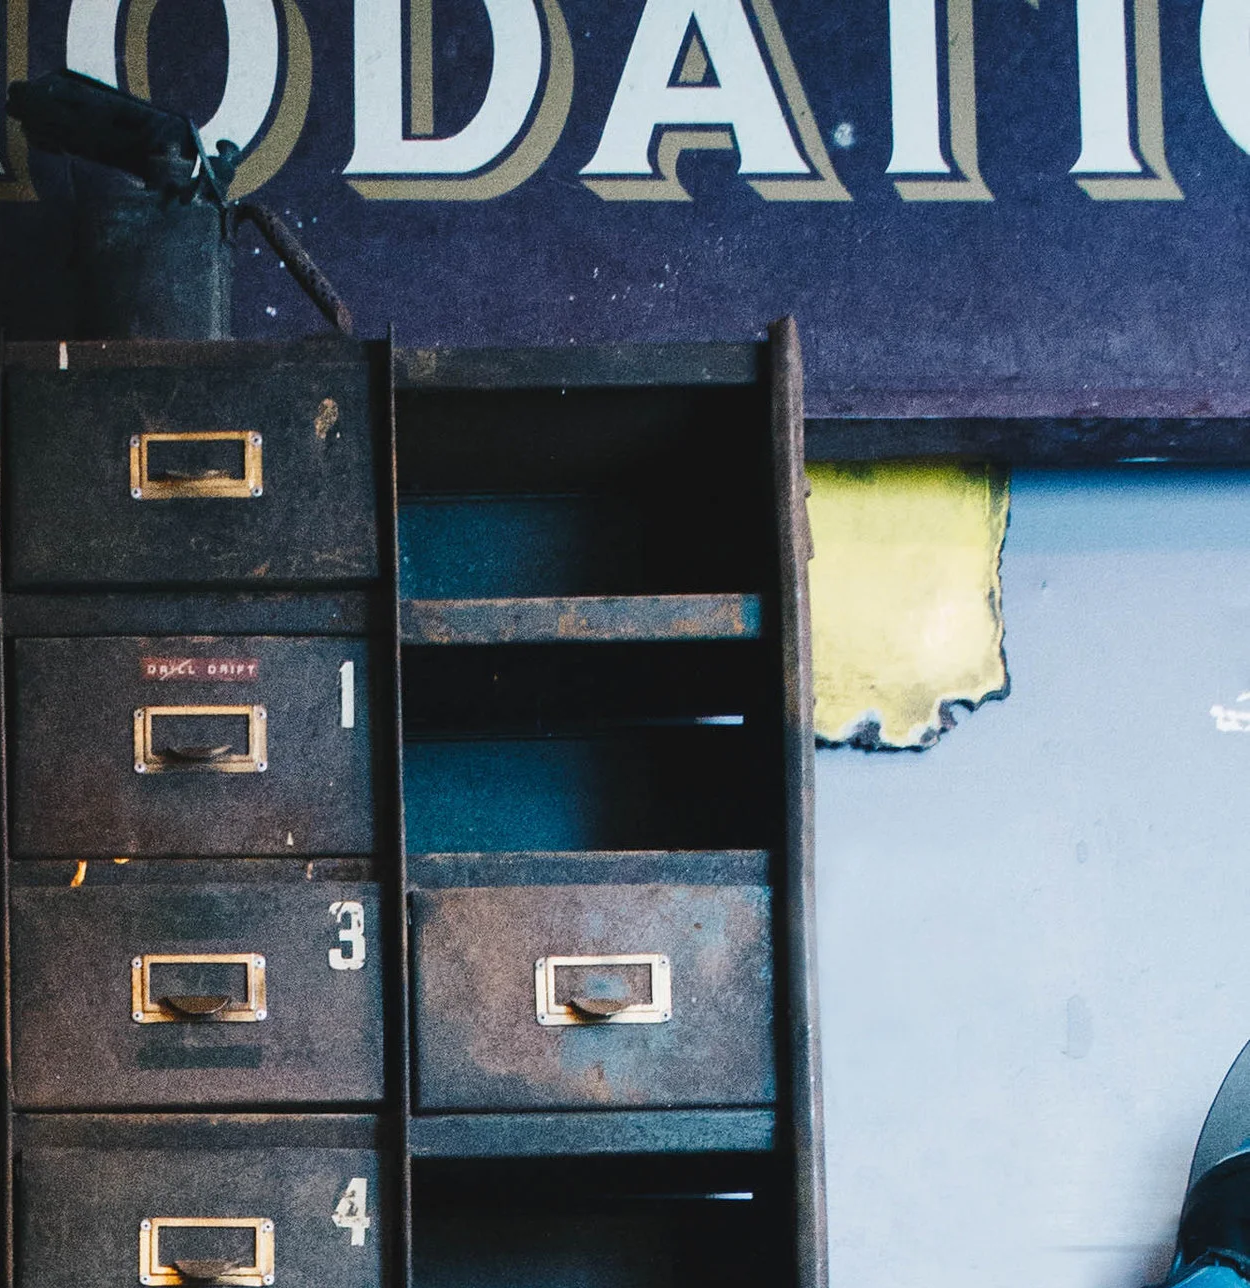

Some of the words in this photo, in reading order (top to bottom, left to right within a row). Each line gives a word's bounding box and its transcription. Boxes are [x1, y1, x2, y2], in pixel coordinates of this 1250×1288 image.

[147, 664, 195, 675] DRILL
[207, 664, 255, 675] DRIFT
[338, 662, 355, 729] 1
[329, 902, 365, 970] 3
[332, 1178, 370, 1246] 4
